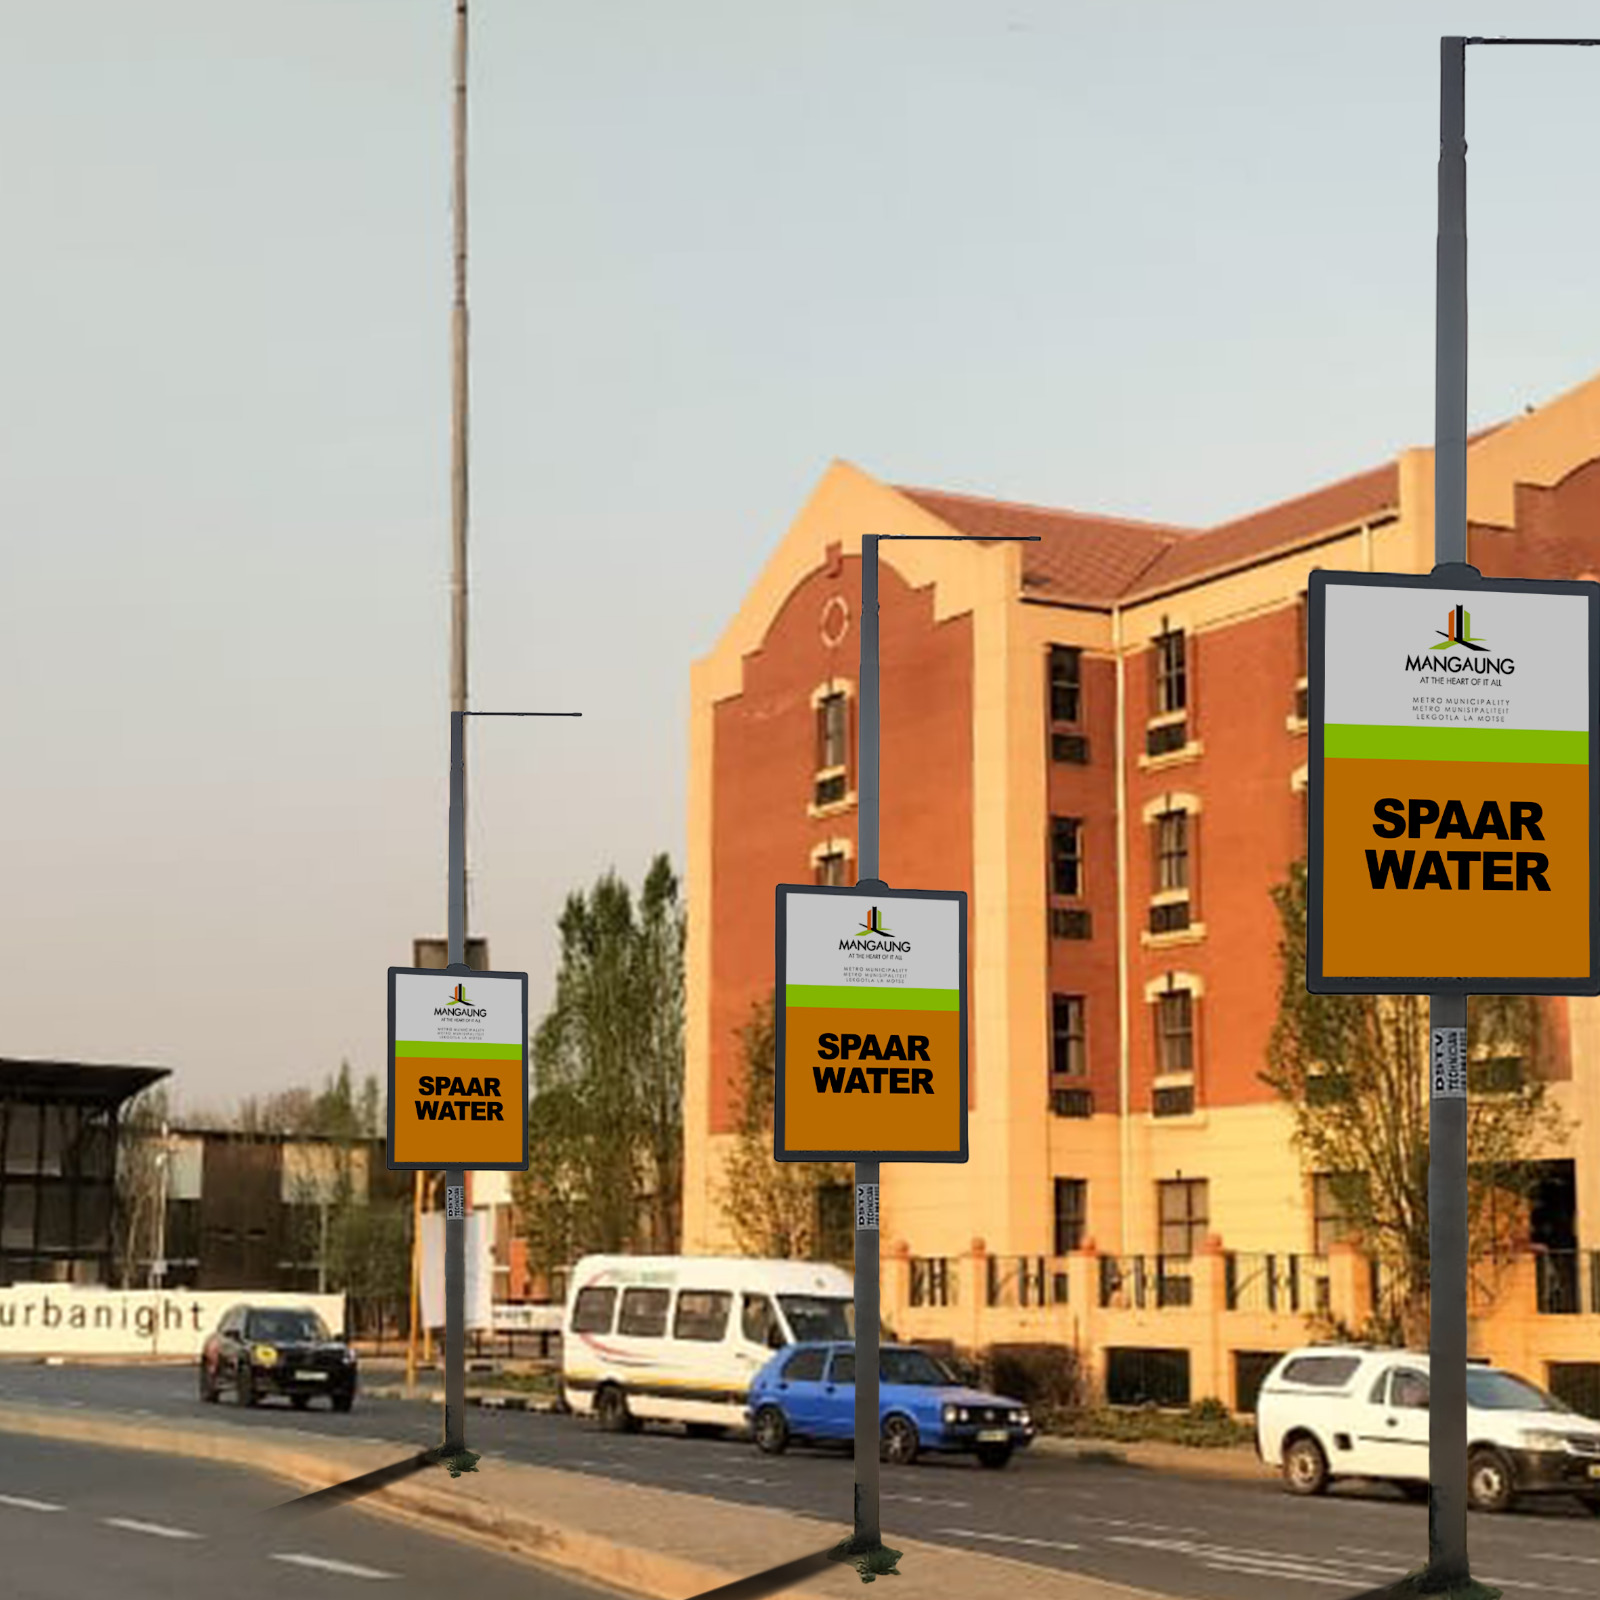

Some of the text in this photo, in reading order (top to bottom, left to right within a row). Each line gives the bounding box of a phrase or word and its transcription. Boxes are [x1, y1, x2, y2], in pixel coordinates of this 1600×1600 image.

[1405, 654, 1515, 675] MANGAUNG
[1446, 698, 1510, 706] MUNICIPALITY
[1373, 798, 1545, 840] SPAAR
[1365, 850, 1551, 891] WATER
[838, 939, 911, 953] MANGAUNG
[434, 1008, 487, 1017] MANGAUNG
[818, 1032, 930, 1061] SPAAR
[419, 1076, 501, 1097] SPAAR
[813, 1066, 934, 1094] WATER
[415, 1101, 504, 1121] WATER
